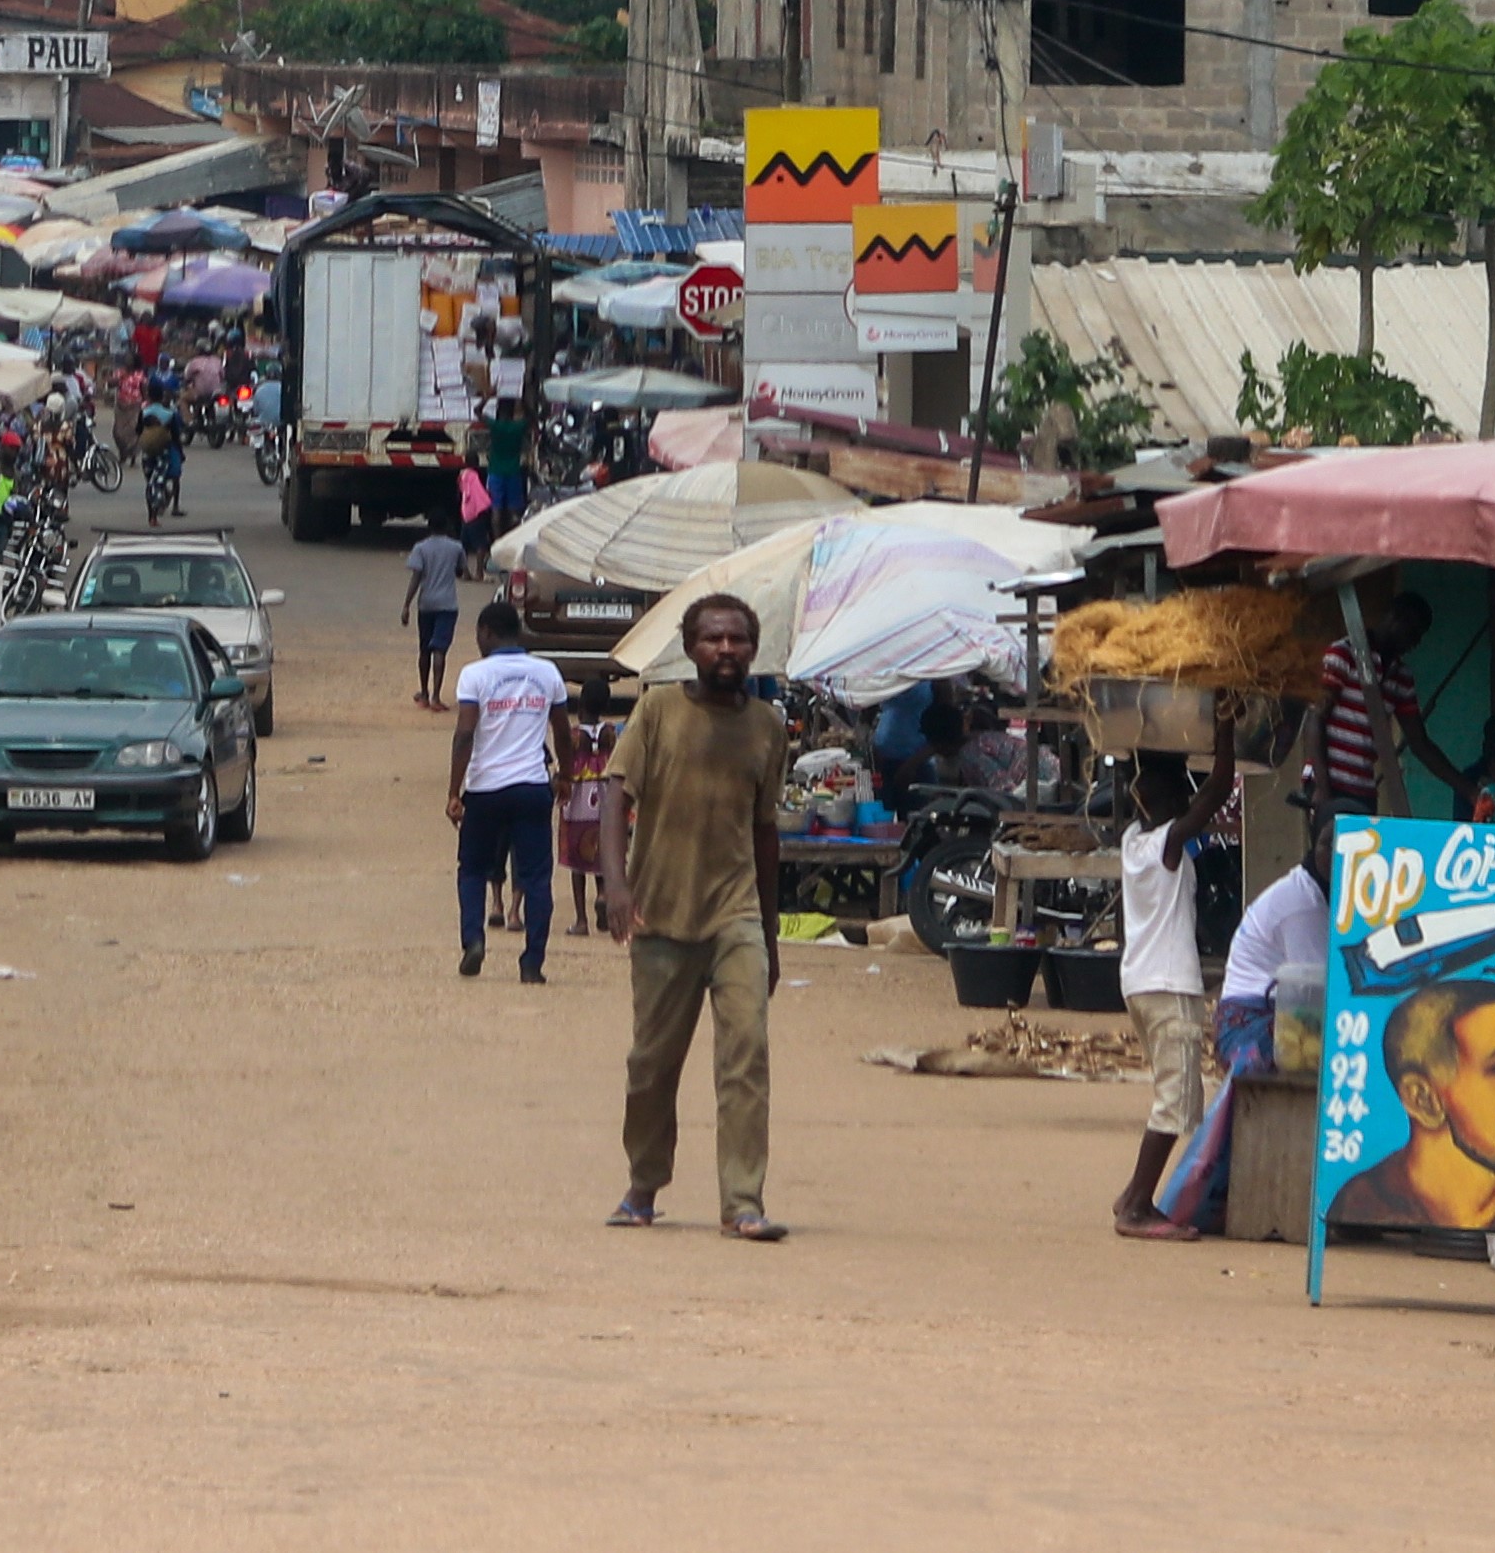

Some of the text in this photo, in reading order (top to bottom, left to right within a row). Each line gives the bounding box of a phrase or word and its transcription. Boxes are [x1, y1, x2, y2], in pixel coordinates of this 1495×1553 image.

[27, 36, 97, 69] PAUL
[781, 385, 865, 402] MoneyGram
[1336, 828, 1425, 933] Top
[1336, 1009, 1369, 1048] 90
[1326, 1091, 1370, 1127] 44
[1323, 1128, 1364, 1163] 36
